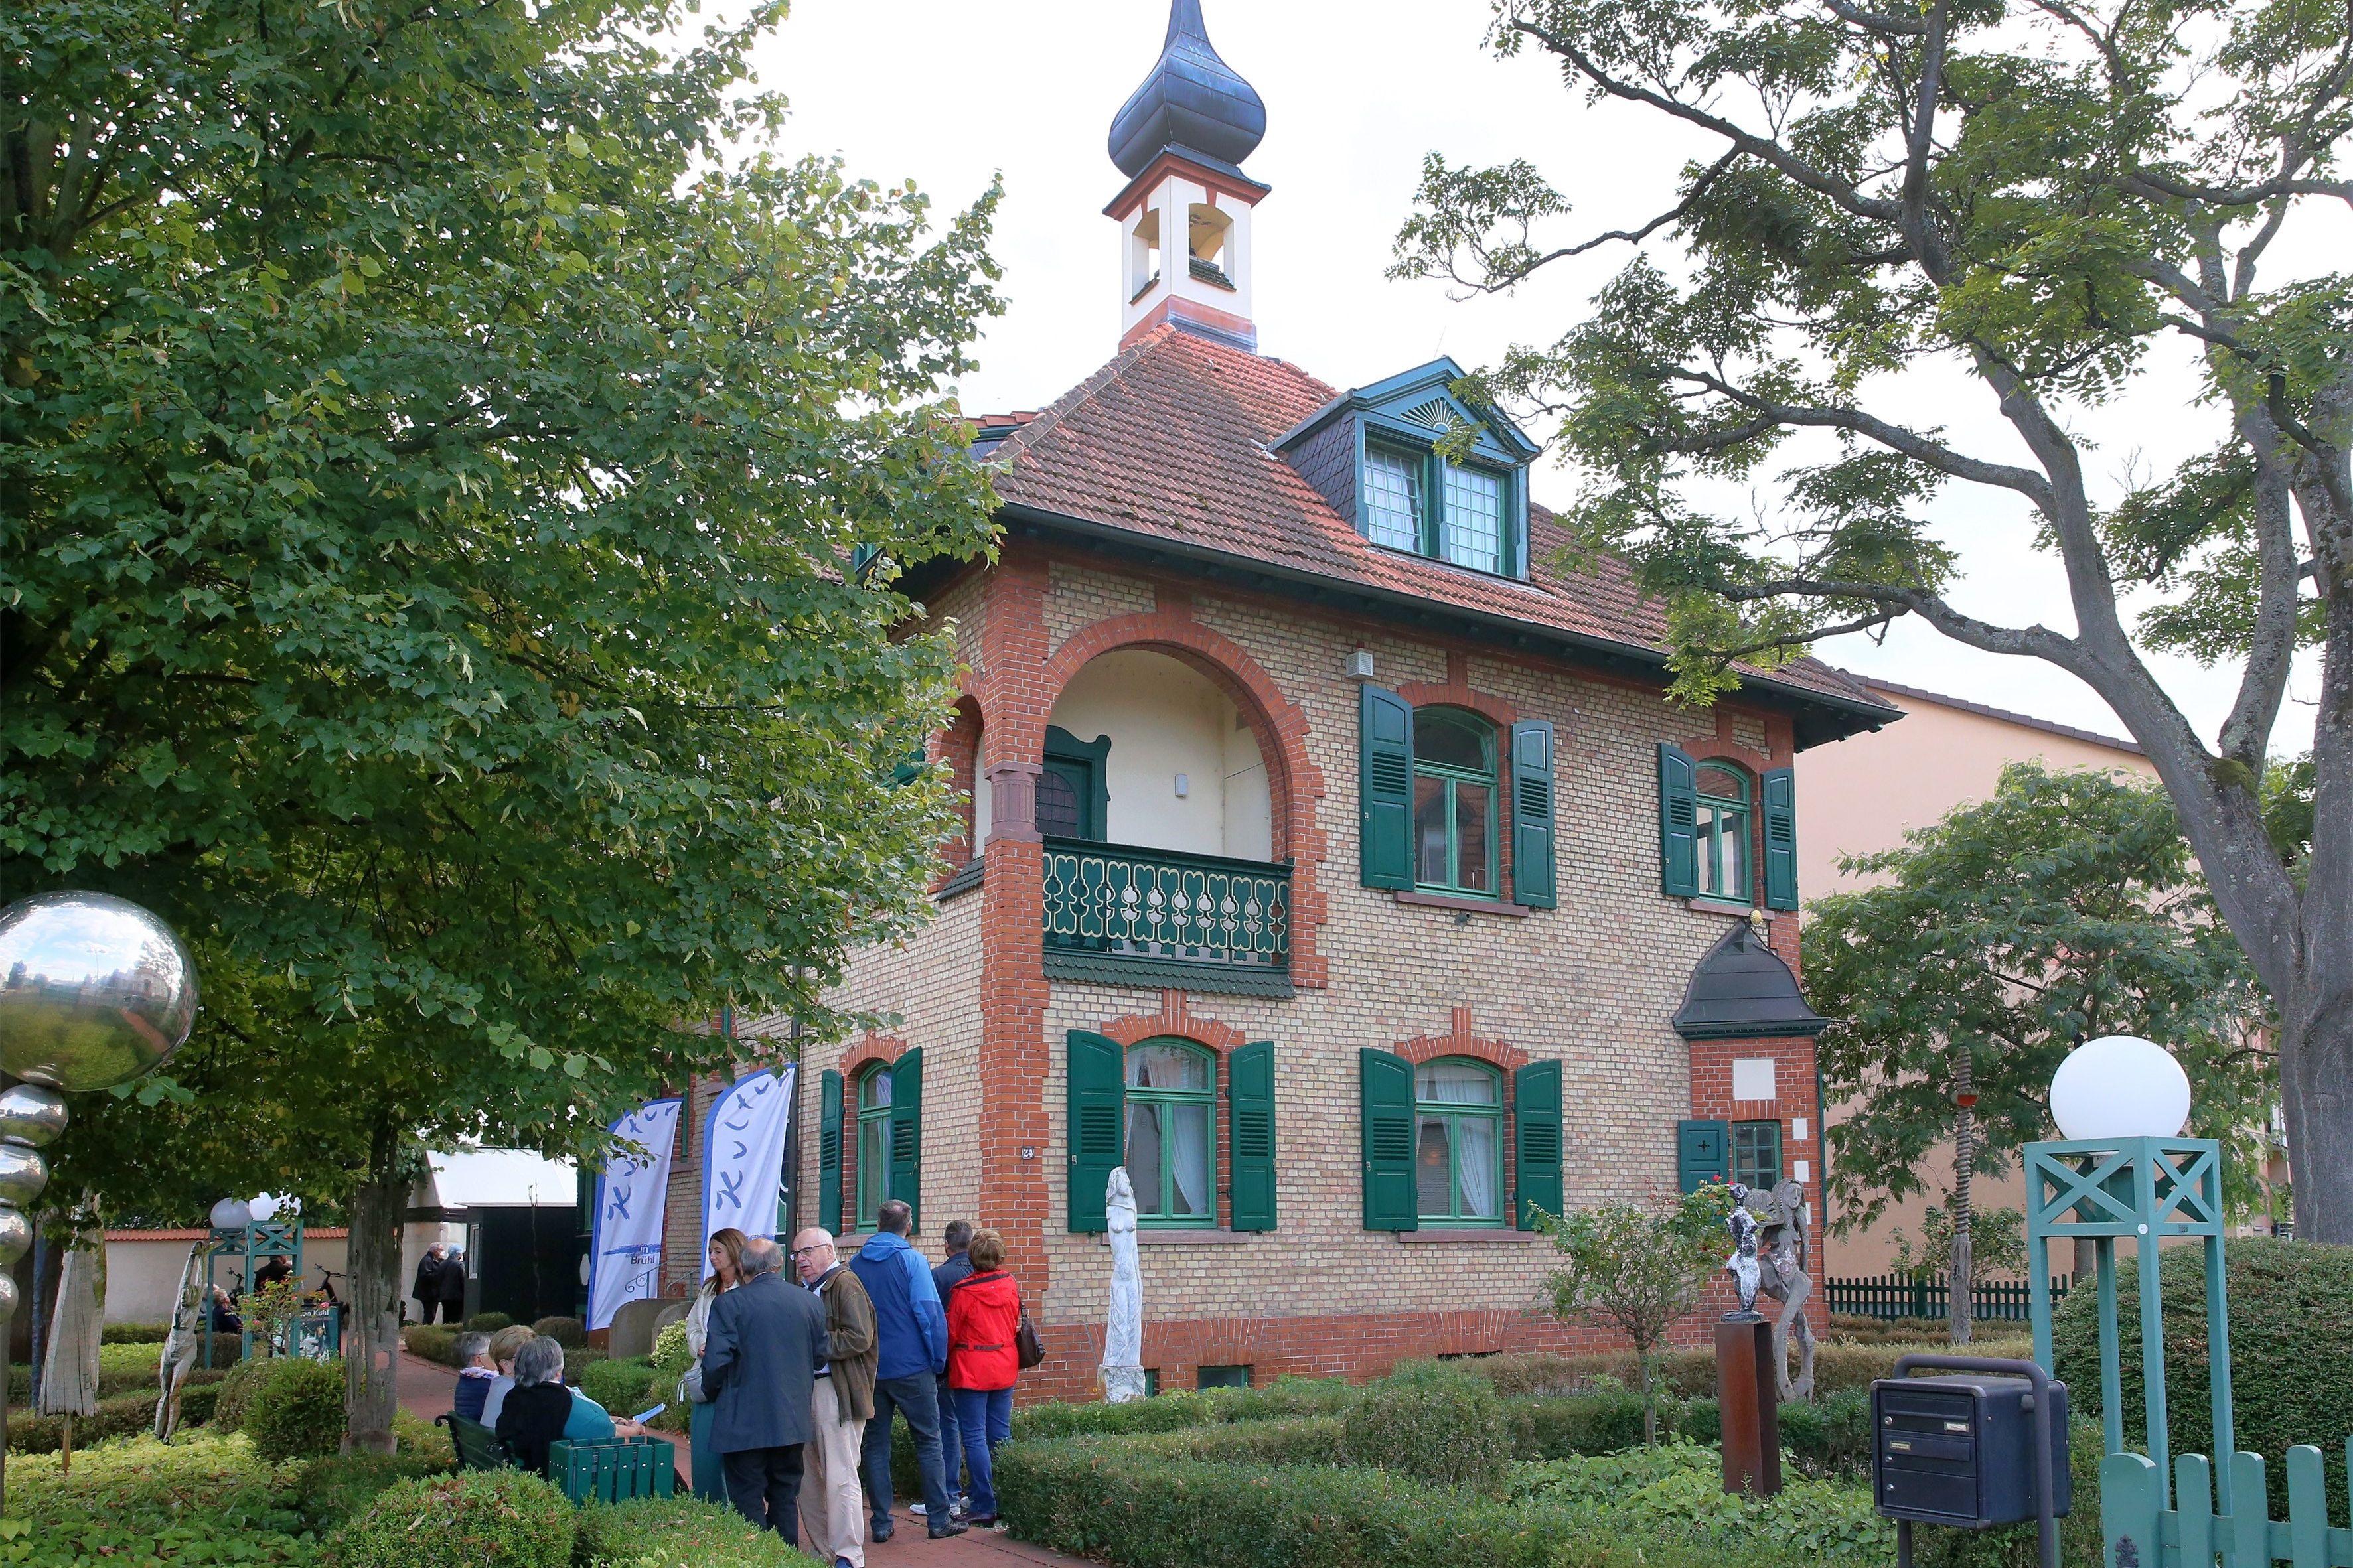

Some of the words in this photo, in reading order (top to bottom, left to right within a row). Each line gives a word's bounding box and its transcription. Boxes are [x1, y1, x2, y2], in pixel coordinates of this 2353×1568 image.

[1023, 1149, 1033, 1157] 24
[607, 1104, 676, 1221] Kutur
[631, 1255, 655, 1265] Brühl
